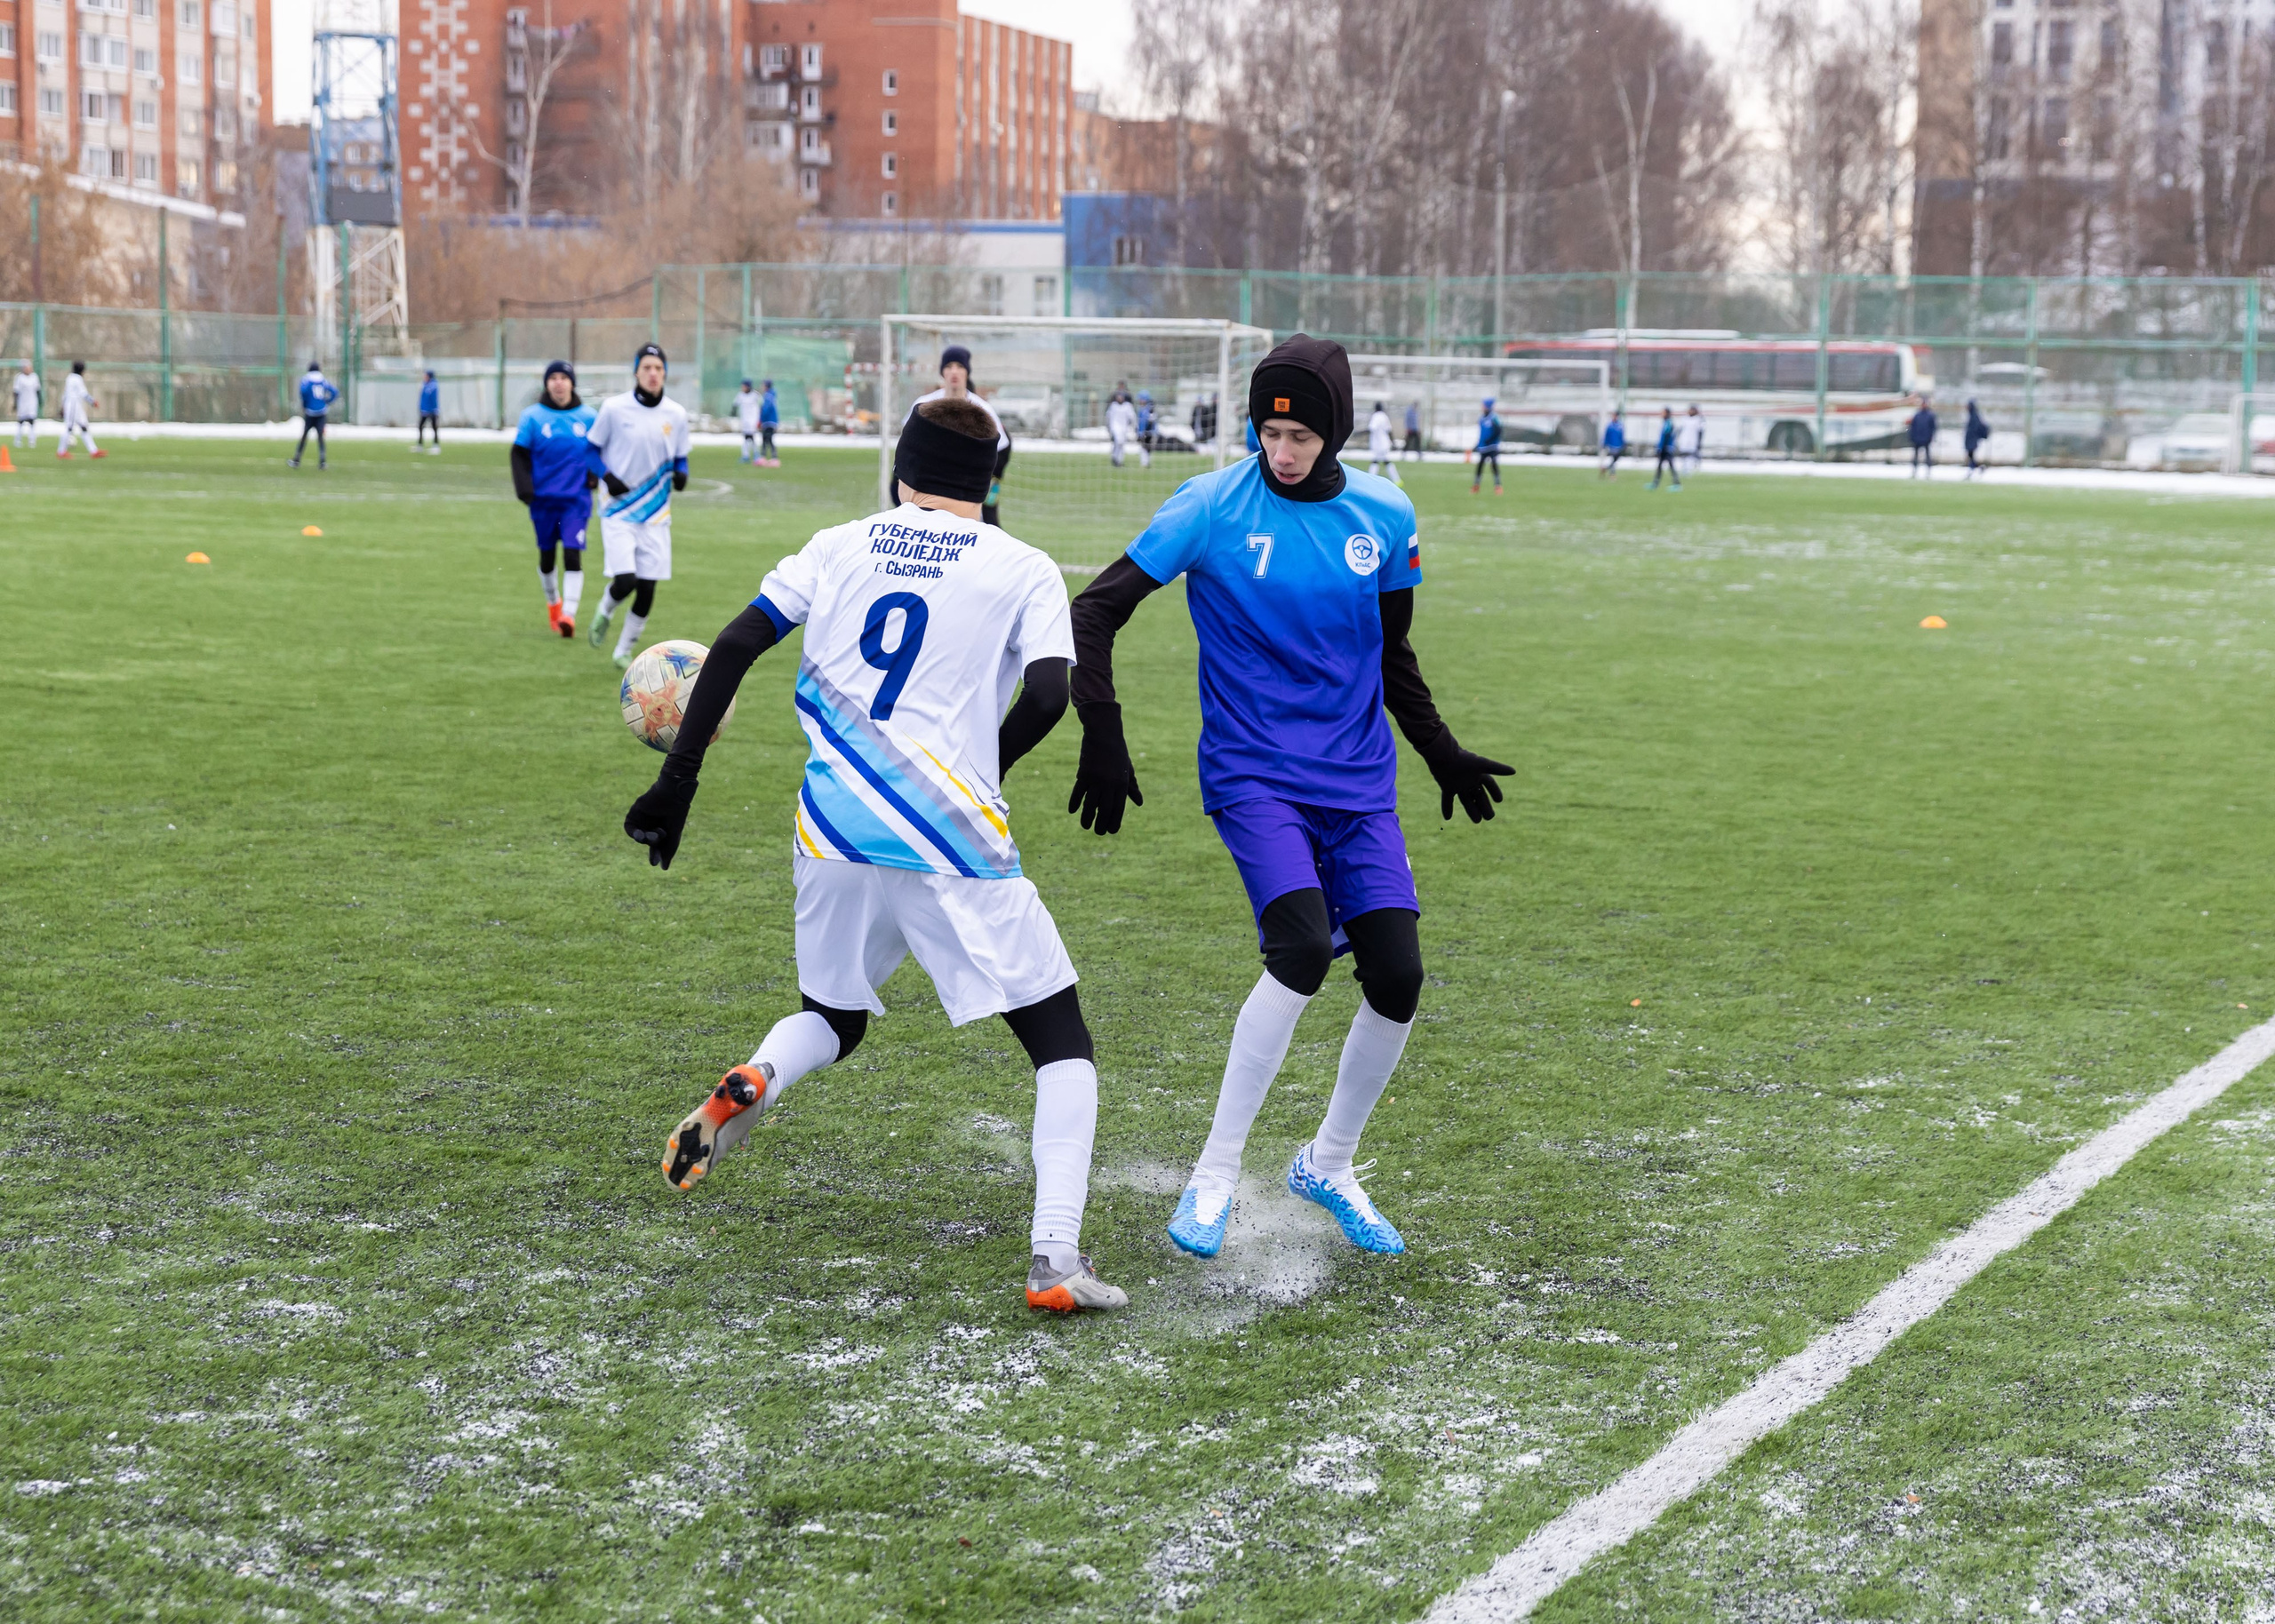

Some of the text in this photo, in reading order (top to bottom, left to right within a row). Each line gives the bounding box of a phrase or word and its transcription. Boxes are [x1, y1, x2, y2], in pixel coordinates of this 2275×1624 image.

[868, 523, 978, 546] ГУБЕРНСКИЙ
[870, 538, 962, 562] КОЛЛЕДЖ
[1247, 533, 1274, 579] 7
[885, 561, 944, 578] СЫЗРАНЬ
[859, 592, 929, 720] 9
